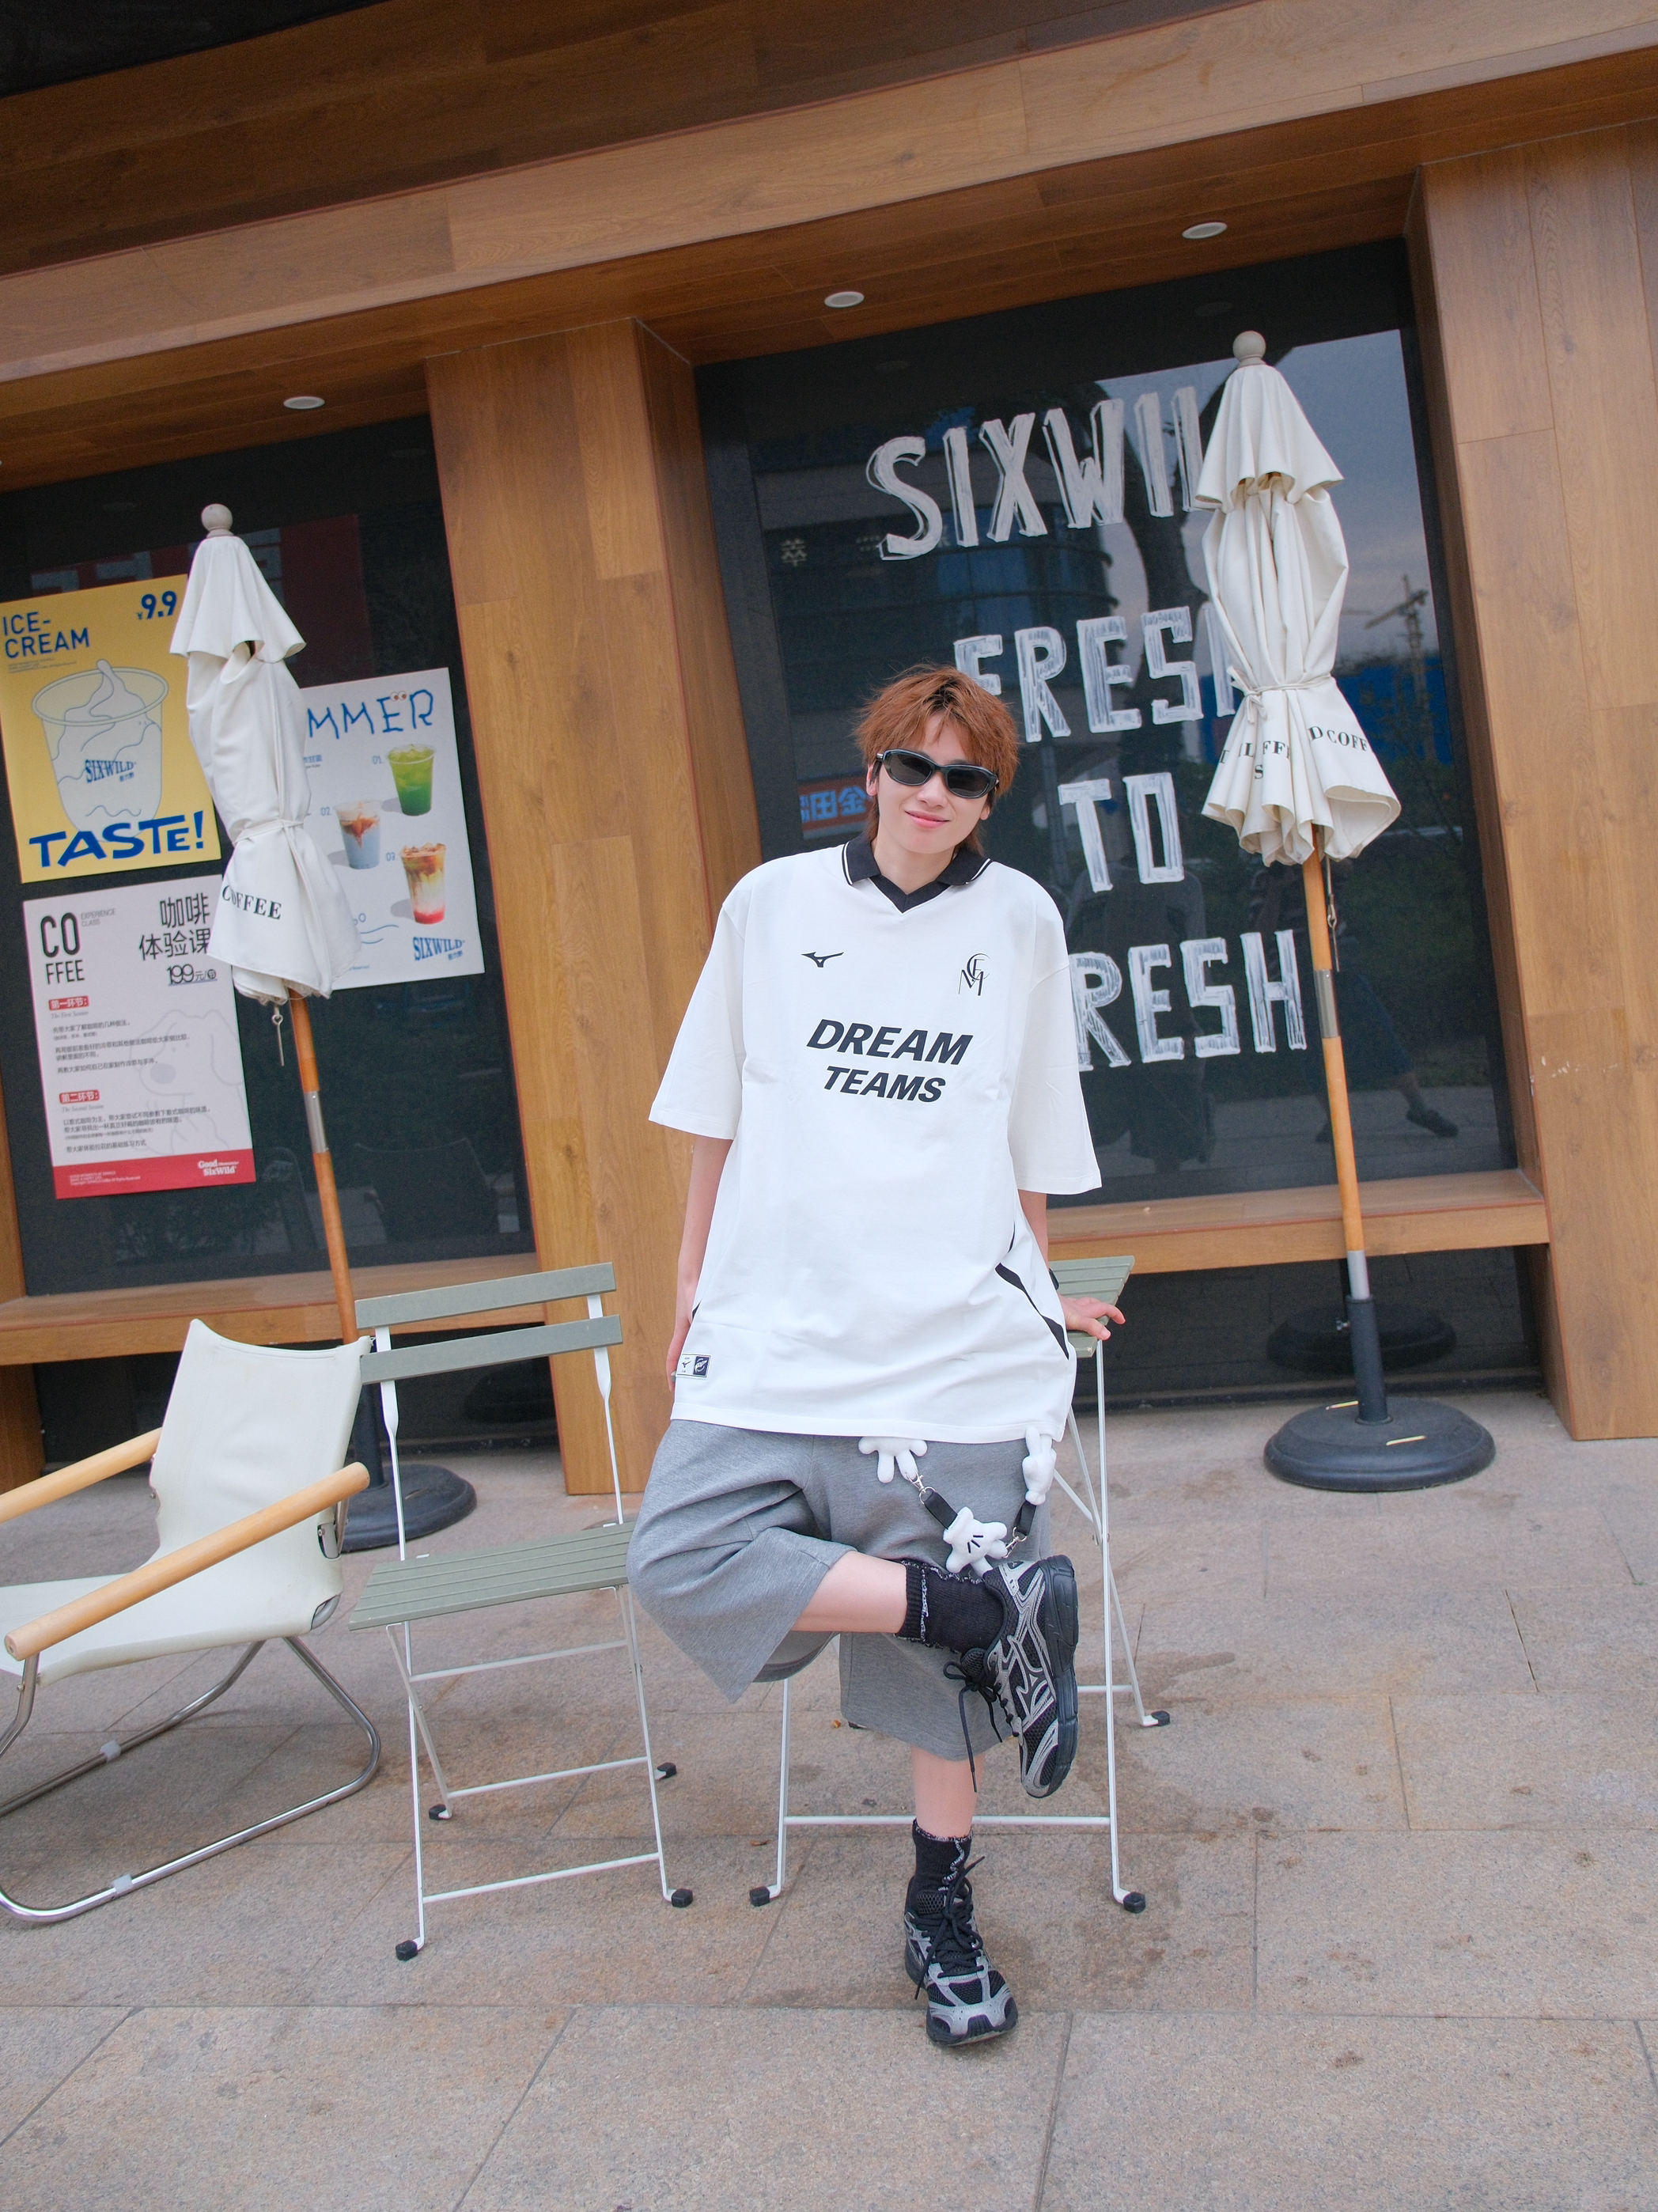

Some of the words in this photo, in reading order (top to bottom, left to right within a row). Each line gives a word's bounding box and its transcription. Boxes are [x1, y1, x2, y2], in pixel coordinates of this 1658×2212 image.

[2, 611, 51, 637] ICE-
[5, 627, 90, 659] CREAM
[307, 689, 433, 740] MMER
[1327, 729, 1368, 752] COFF
[85, 759, 135, 784] SIXWILD
[28, 810, 204, 867] TASTE!
[1058, 771, 1184, 892] TO
[81, 908, 116, 919] EXPERIENCE
[160, 892, 210, 928] 咖啡
[221, 884, 282, 920] COFFEE
[40, 912, 81, 957] CO
[81, 919, 100, 927] CLASS
[138, 928, 211, 961] 体验课
[413, 937, 464, 960] SIXWILD
[46, 960, 85, 984] FFEE
[1069, 929, 1307, 1071] RESH
[806, 1018, 974, 1066] DREAM
[823, 1065, 947, 1103] TEAMS
[199, 1160, 217, 1169] Good
[203, 1165, 236, 1176] SixWild
